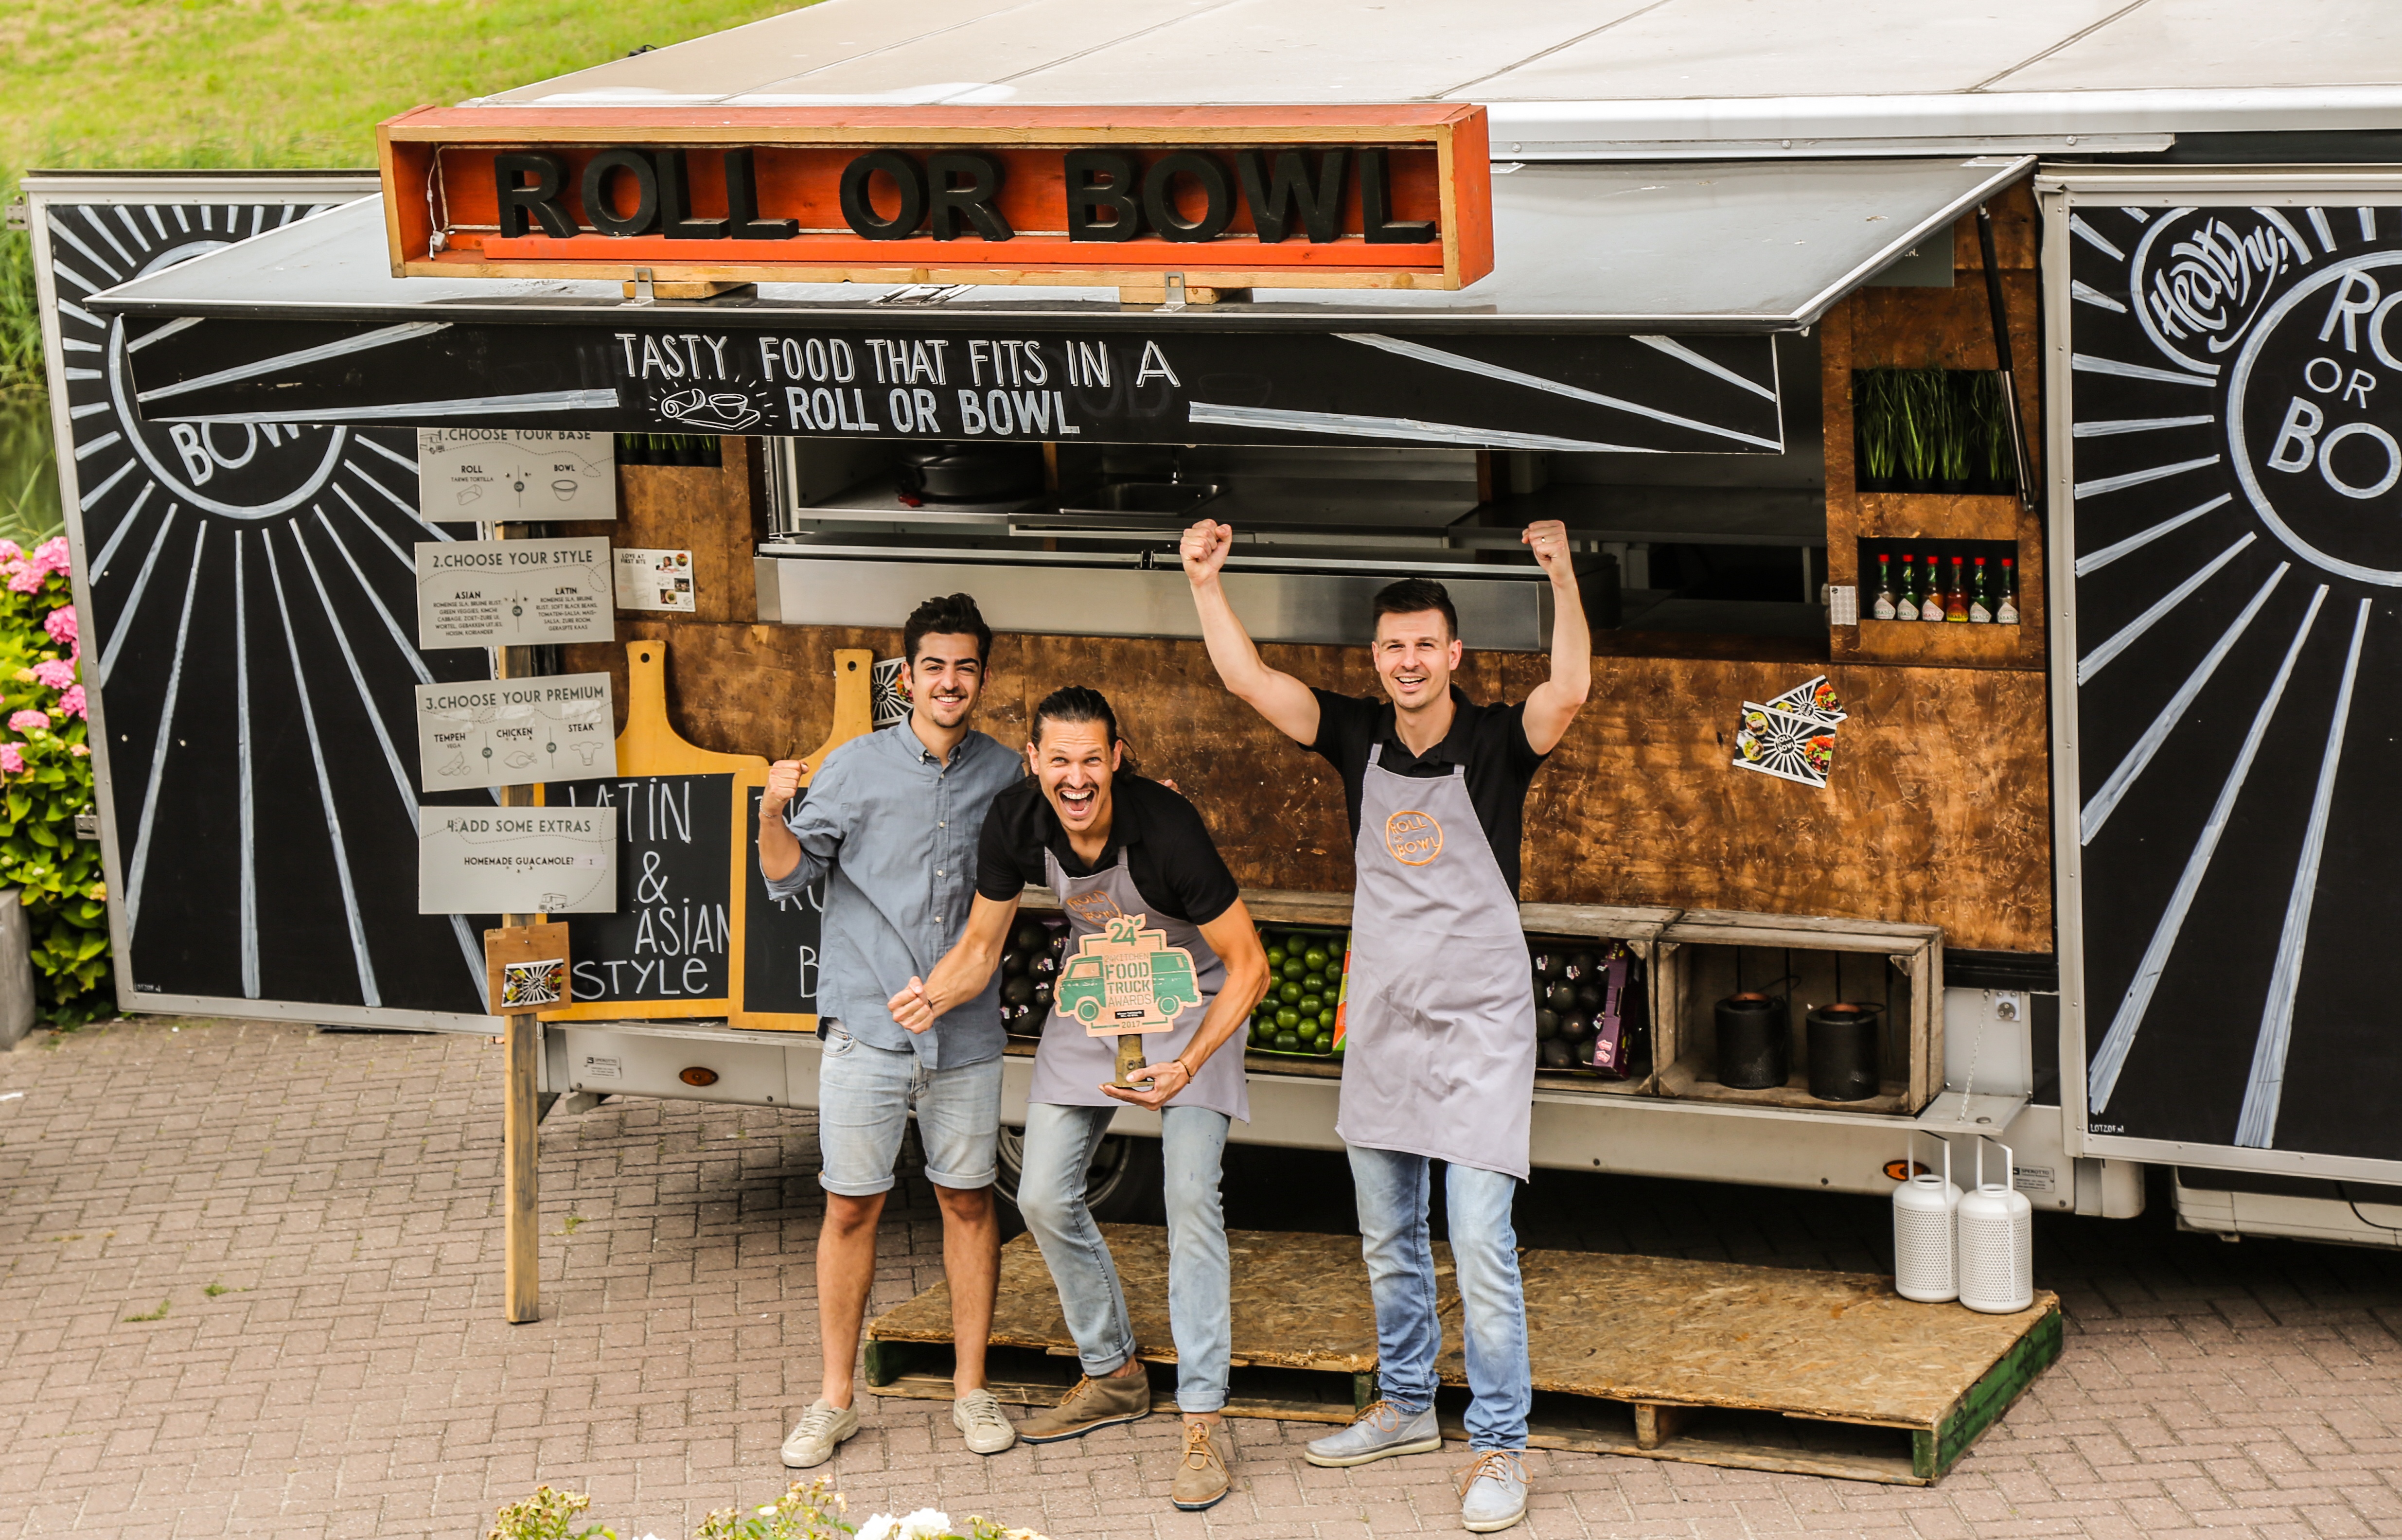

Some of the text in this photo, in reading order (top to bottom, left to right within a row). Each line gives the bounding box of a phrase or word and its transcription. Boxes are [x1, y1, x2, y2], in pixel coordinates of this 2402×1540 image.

[494, 147, 1436, 244] ROLL OR BOWL
[615, 333, 1181, 387] TASTY FOOD THAT FITS IN A
[2305, 357, 2377, 409] OR
[785, 386, 880, 431] ROLL
[889, 388, 941, 433] OR
[958, 389, 1080, 435] BOWL
[515, 429, 552, 441] YOUR
[559, 431, 591, 440] BASE
[461, 465, 483, 474] ROLL
[433, 550, 593, 568] 2.CHOOSE YOUR STYLE
[425, 686, 603, 710] 3.CHOOSE YOUR PREMIUM
[496, 728, 532, 738] CHICKEN
[568, 723, 594, 732] STEAK
[434, 733, 466, 743] TEMPEH
[496, 820, 532, 832] SOME
[539, 820, 591, 832] EXTRAS
[1389, 816, 1428, 835] ROLL
[1395, 836, 1440, 857] BOWL
[637, 851, 668, 904] &
[1110, 922, 1137, 946] 24
[1106, 962, 1149, 980] FOOD
[1107, 980, 1151, 995] TRUCK
[1109, 994, 1152, 1008] AWARDS
[1122, 1020, 1141, 1028] 2017
